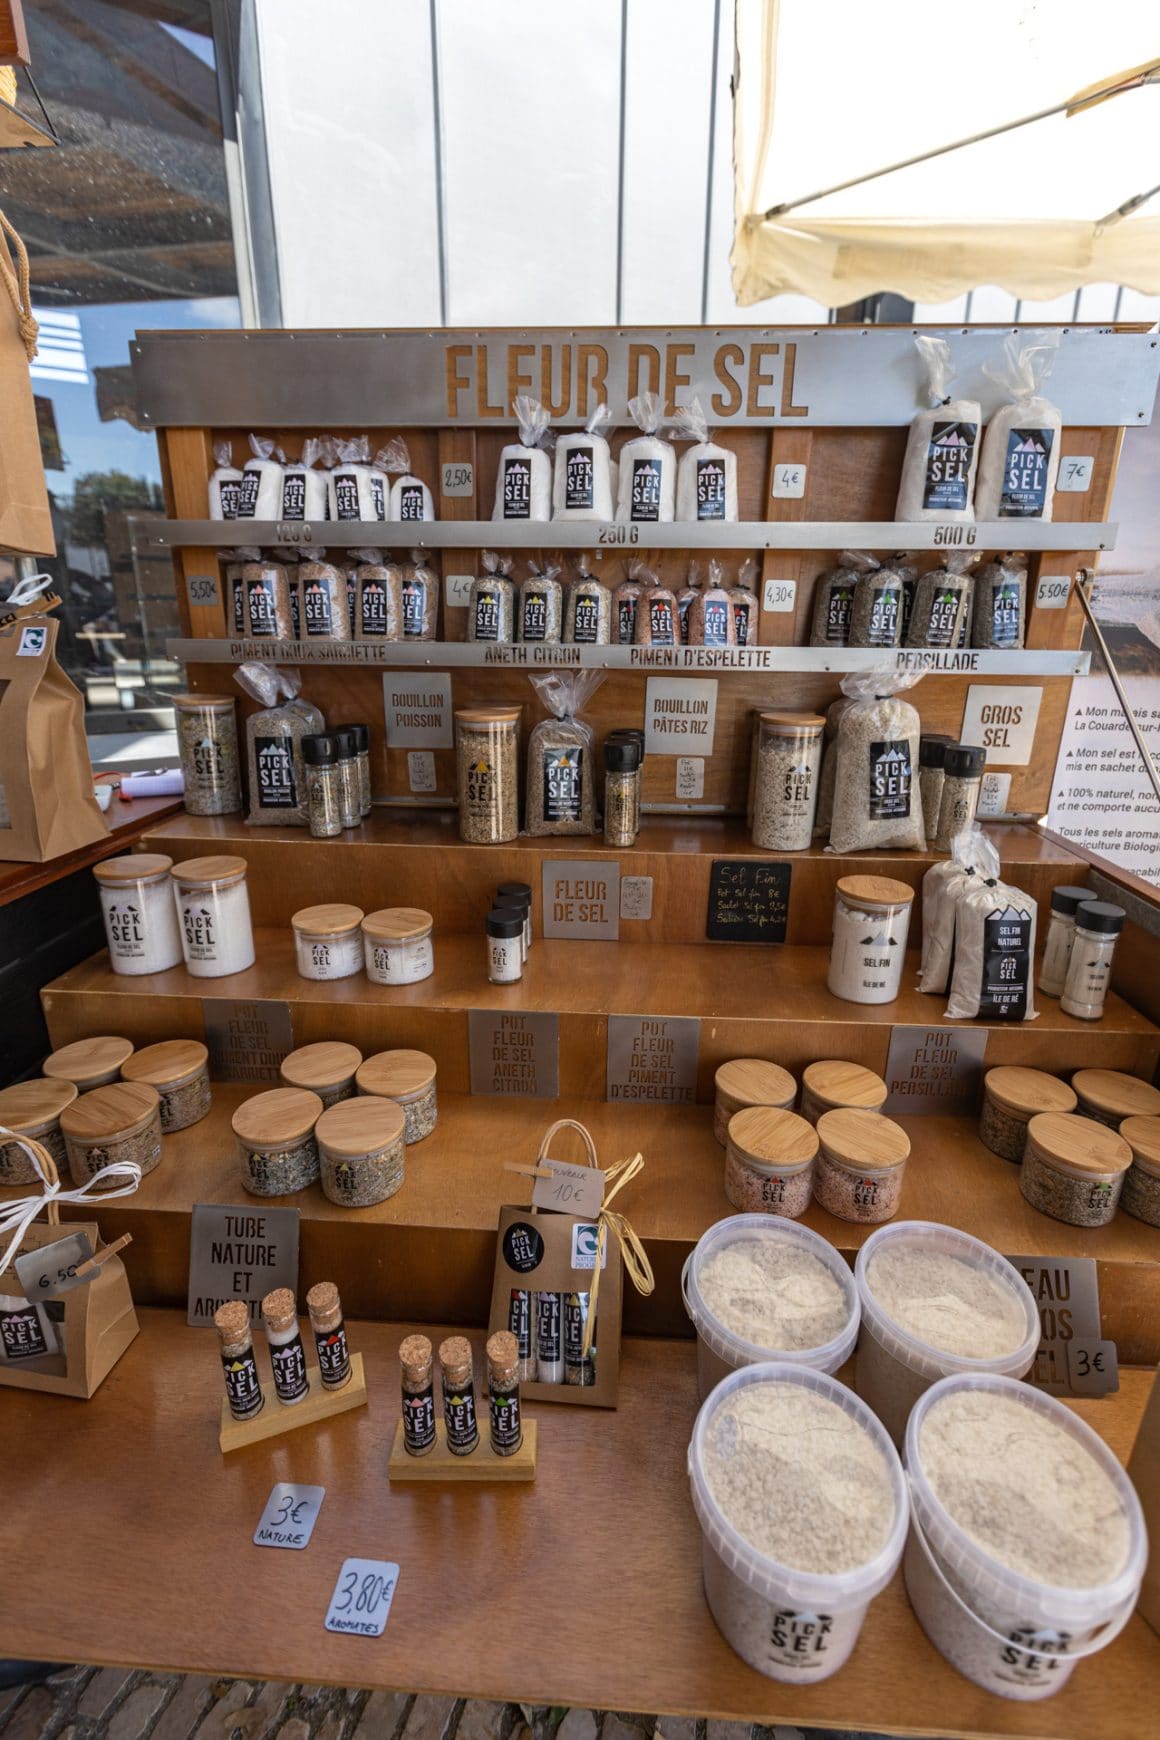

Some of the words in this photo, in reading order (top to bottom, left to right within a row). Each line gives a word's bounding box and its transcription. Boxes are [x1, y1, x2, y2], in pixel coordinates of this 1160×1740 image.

[446, 344, 608, 418] FLEUR
[628, 344, 695, 418] DE
[711, 343, 809, 417] SEL
[933, 447, 968, 462] PICK
[1011, 454, 1043, 469] PICK
[445, 466, 472, 488] 2,50€
[568, 465, 592, 476] PICK
[781, 469, 799, 485] 4€
[931, 462, 966, 482] SEL
[1067, 463, 1085, 481] 7€
[505, 475, 529, 485] PICK
[568, 476, 592, 491] SEL
[633, 476, 659, 487] PICK
[698, 475, 723, 486] PICK
[1009, 469, 1041, 490] SEL
[239, 491, 256, 503] SEL
[284, 487, 304, 496] PICK
[336, 488, 357, 498] PICK
[505, 486, 529, 500] SEL
[633, 488, 658, 503] SEL
[698, 487, 724, 501] SEL
[283, 496, 304, 507] SEL
[337, 498, 358, 510] SEL
[402, 498, 422, 507] PICK
[401, 507, 423, 519] SEL
[277, 524, 300, 542] 125
[599, 526, 625, 544] 250
[630, 526, 639, 543] G
[934, 526, 963, 545] 500
[966, 527, 977, 545] G
[249, 594, 274, 605] PICK
[305, 594, 329, 605] PICK
[362, 593, 385, 604] PICK
[767, 586, 793, 603] 4,30€
[250, 605, 274, 619] SEL
[306, 605, 330, 619] SEL
[362, 605, 386, 618] SEL
[478, 604, 498, 615] PICK
[525, 604, 545, 615] PICK
[576, 607, 598, 616] PICK
[873, 603, 896, 615] PICK
[933, 603, 956, 615] PICK
[994, 600, 1019, 610] PICK
[477, 614, 497, 626] SEL
[525, 614, 544, 626] SEL
[576, 616, 596, 629] SEL
[652, 611, 671, 620] PICK
[705, 613, 726, 623] PICK
[871, 615, 896, 630] SEL
[930, 614, 954, 629] SEL
[994, 610, 1018, 623] SEL
[652, 619, 672, 631] SEL
[705, 623, 725, 635] SEL
[485, 647, 526, 664] ANETH
[534, 647, 580, 665] CITRON
[631, 648, 678, 666] PIMENT
[685, 649, 771, 667] D'ESPELETTE
[896, 652, 979, 670] PERSILLADE
[392, 693, 443, 708] BOUILLON
[654, 698, 708, 714] BOUILLON
[981, 705, 1023, 724] GROS
[1085, 706, 1112, 717] Mon
[396, 713, 441, 728] POISSON
[653, 715, 688, 733] PÂTES
[691, 720, 707, 734] RIZ
[1075, 721, 1086, 731] La
[983, 729, 1010, 748] SEL
[1076, 748, 1098, 758] Mon
[1101, 748, 1117, 758] sel
[1119, 751, 1136, 759] est
[195, 761, 224, 775] SEL
[260, 756, 289, 769] PICK
[875, 764, 908, 776] PICK
[1085, 764, 1098, 772] en
[1100, 763, 1135, 773] sachet
[261, 770, 291, 786] SEL
[548, 768, 579, 780] PICK
[786, 774, 811, 785] PICK
[549, 782, 578, 798] SEL
[784, 786, 810, 800] SEL
[876, 778, 908, 795] SEL
[1068, 788, 1093, 798] 100%
[1068, 803, 1080, 811] ne
[1082, 803, 1131, 814] comporte
[1059, 827, 1083, 837] Tous
[1084, 828, 1099, 837] les
[1102, 829, 1122, 838] sels
[555, 880, 606, 900] FLEUR
[109, 913, 140, 925] PICK
[553, 903, 574, 922] DE
[579, 904, 608, 923] SEL
[184, 915, 213, 927] PICK
[112, 926, 143, 941] SEL
[186, 929, 215, 945] SEL
[313, 956, 330, 966] SEL
[374, 960, 391, 970] SEL
[863, 957, 879, 968] SEL
[880, 958, 891, 968] FIN
[1000, 970, 1016, 979] SEL
[501, 1016, 526, 1031] POT
[641, 1021, 667, 1036] POT
[494, 1031, 534, 1047] FLEUR
[633, 1037, 674, 1053] FLEUR
[925, 1032, 953, 1047] POT
[493, 1047, 510, 1061] DE
[513, 1048, 536, 1063] SEL
[631, 1054, 649, 1068] DE
[651, 1054, 674, 1070] SEL
[914, 1048, 958, 1064] FLEUR
[494, 1063, 535, 1079] ANETH
[629, 1070, 676, 1086] PIMENT
[910, 1065, 928, 1080] DE
[611, 1084, 692, 1102] D'ESPELETTE
[552, 1183, 585, 1202] 10€
[762, 1192, 785, 1203] SEL
[854, 1194, 877, 1206] SEL
[1088, 1198, 1110, 1209] SEL
[225, 1216, 266, 1238] TUBE
[511, 1236, 530, 1248] PICK
[211, 1242, 276, 1267] NATURE
[514, 1246, 533, 1261] SEL
[233, 1272, 252, 1293] ET
[1021, 1269, 1070, 1302] EAU
[2, 1318, 39, 1333] PICK
[4, 1331, 42, 1345] SEL
[272, 1350, 302, 1371] PICK
[320, 1349, 348, 1368] SEL
[1077, 1350, 1104, 1376] 3€
[274, 1364, 304, 1384] SEL
[226, 1379, 258, 1397] SEL
[404, 1413, 433, 1432] SEL
[270, 1496, 308, 1526] 3€
[258, 1529, 305, 1544] NATURE
[335, 1572, 393, 1614] 3,80€
[327, 1617, 379, 1634] AROMATES
[773, 1615, 832, 1635] PICK
[770, 1629, 828, 1652] SEL
